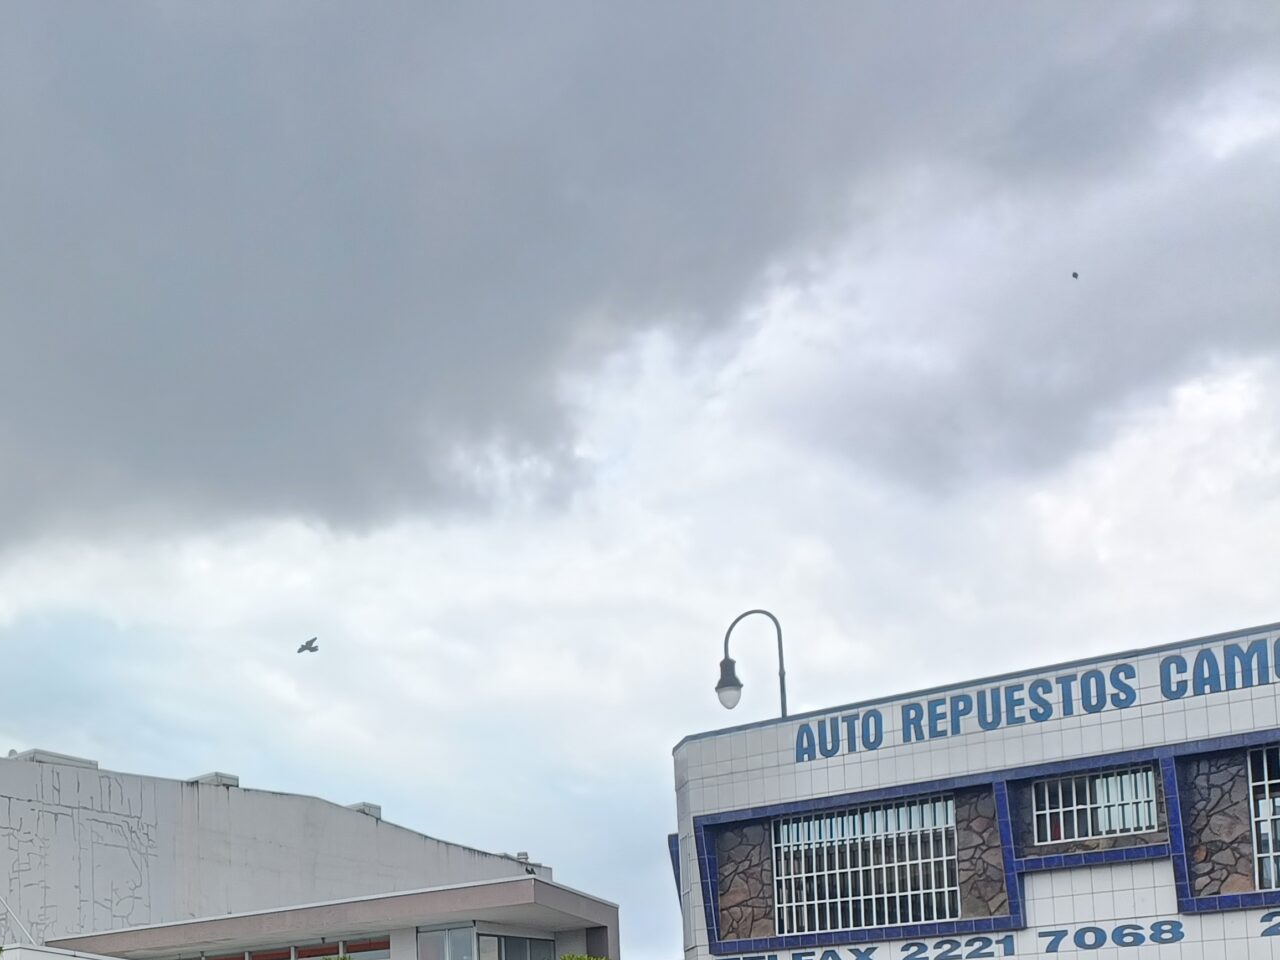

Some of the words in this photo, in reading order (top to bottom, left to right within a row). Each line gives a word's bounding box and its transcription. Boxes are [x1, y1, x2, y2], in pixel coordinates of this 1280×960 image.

[795, 708, 884, 763] AUTO
[901, 664, 1138, 743] REPUESTOS
[1159, 638, 1280, 701] CAM
[1038, 920, 1186, 953] 7068
